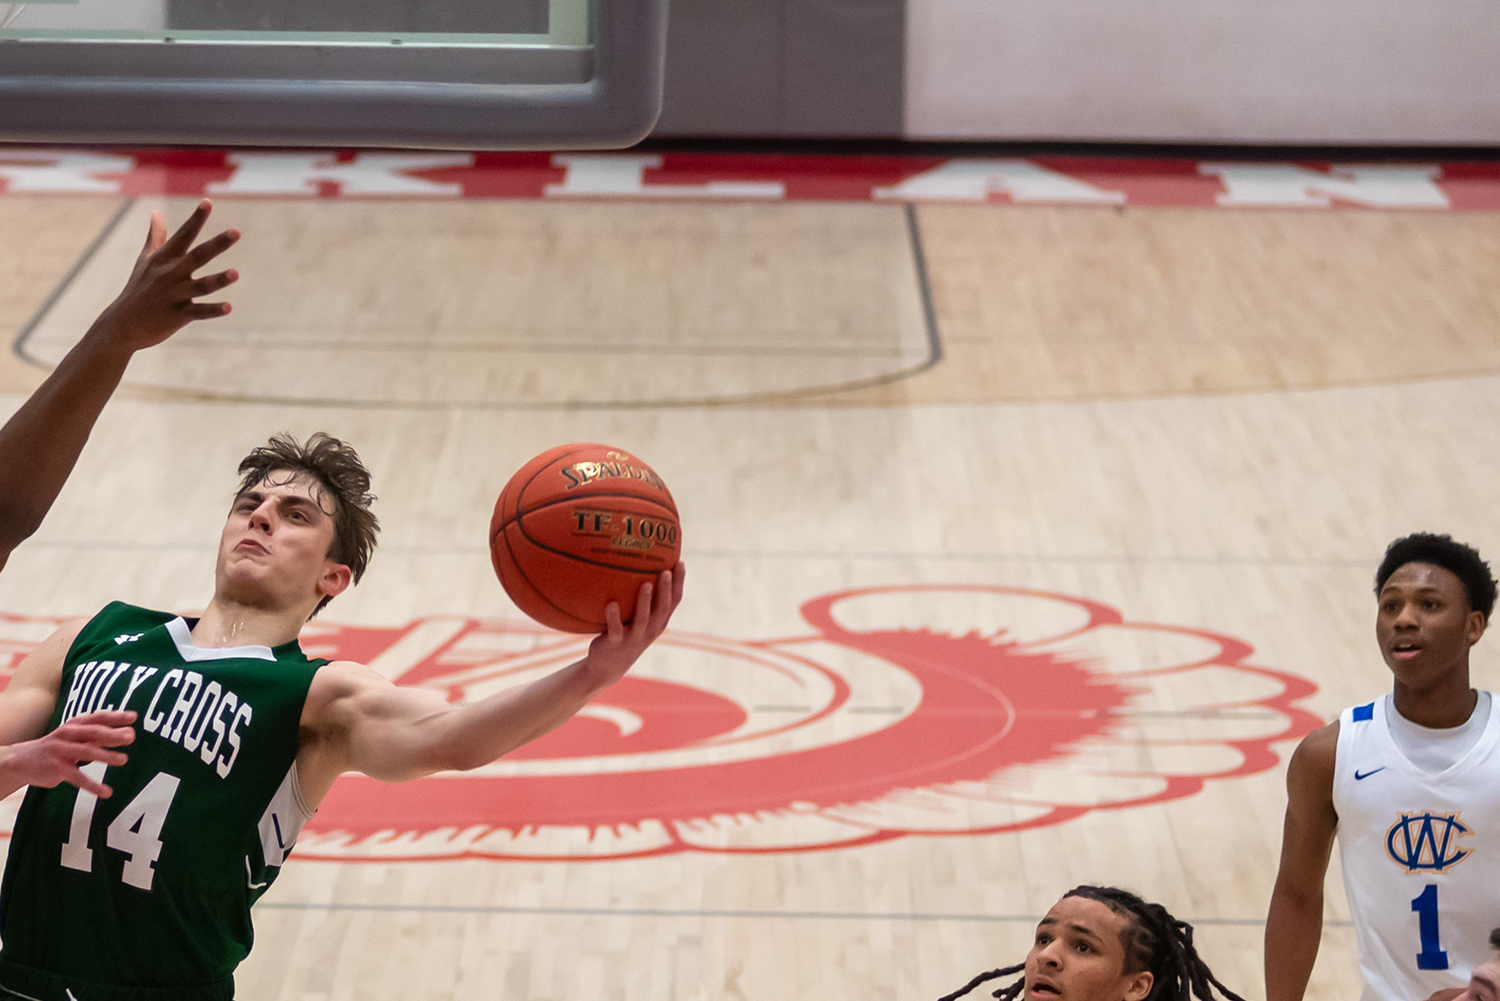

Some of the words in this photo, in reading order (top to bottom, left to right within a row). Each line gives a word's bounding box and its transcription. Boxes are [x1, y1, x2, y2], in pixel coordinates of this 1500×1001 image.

[59, 660, 159, 728] HOLY
[143, 668, 253, 780] CROSS
[60, 760, 181, 891] 14
[1411, 884, 1449, 970] 1
